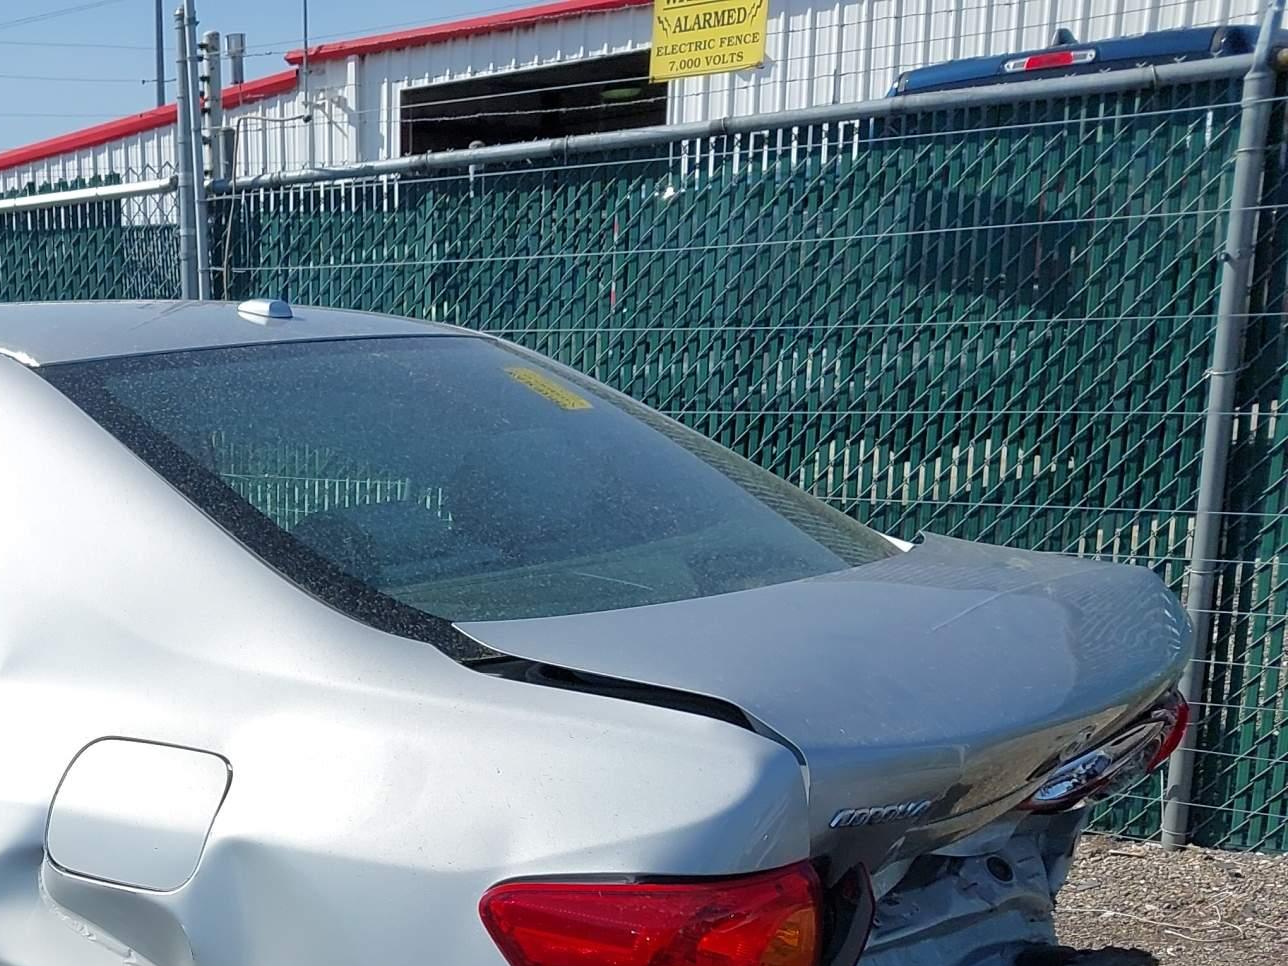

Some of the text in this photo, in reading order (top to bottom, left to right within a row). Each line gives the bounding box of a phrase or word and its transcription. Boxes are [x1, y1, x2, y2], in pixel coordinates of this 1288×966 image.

[672, 6, 747, 34] ALARMED
[656, 32, 760, 57] ELECTRIC FENCE
[705, 52, 744, 67] VOLTS
